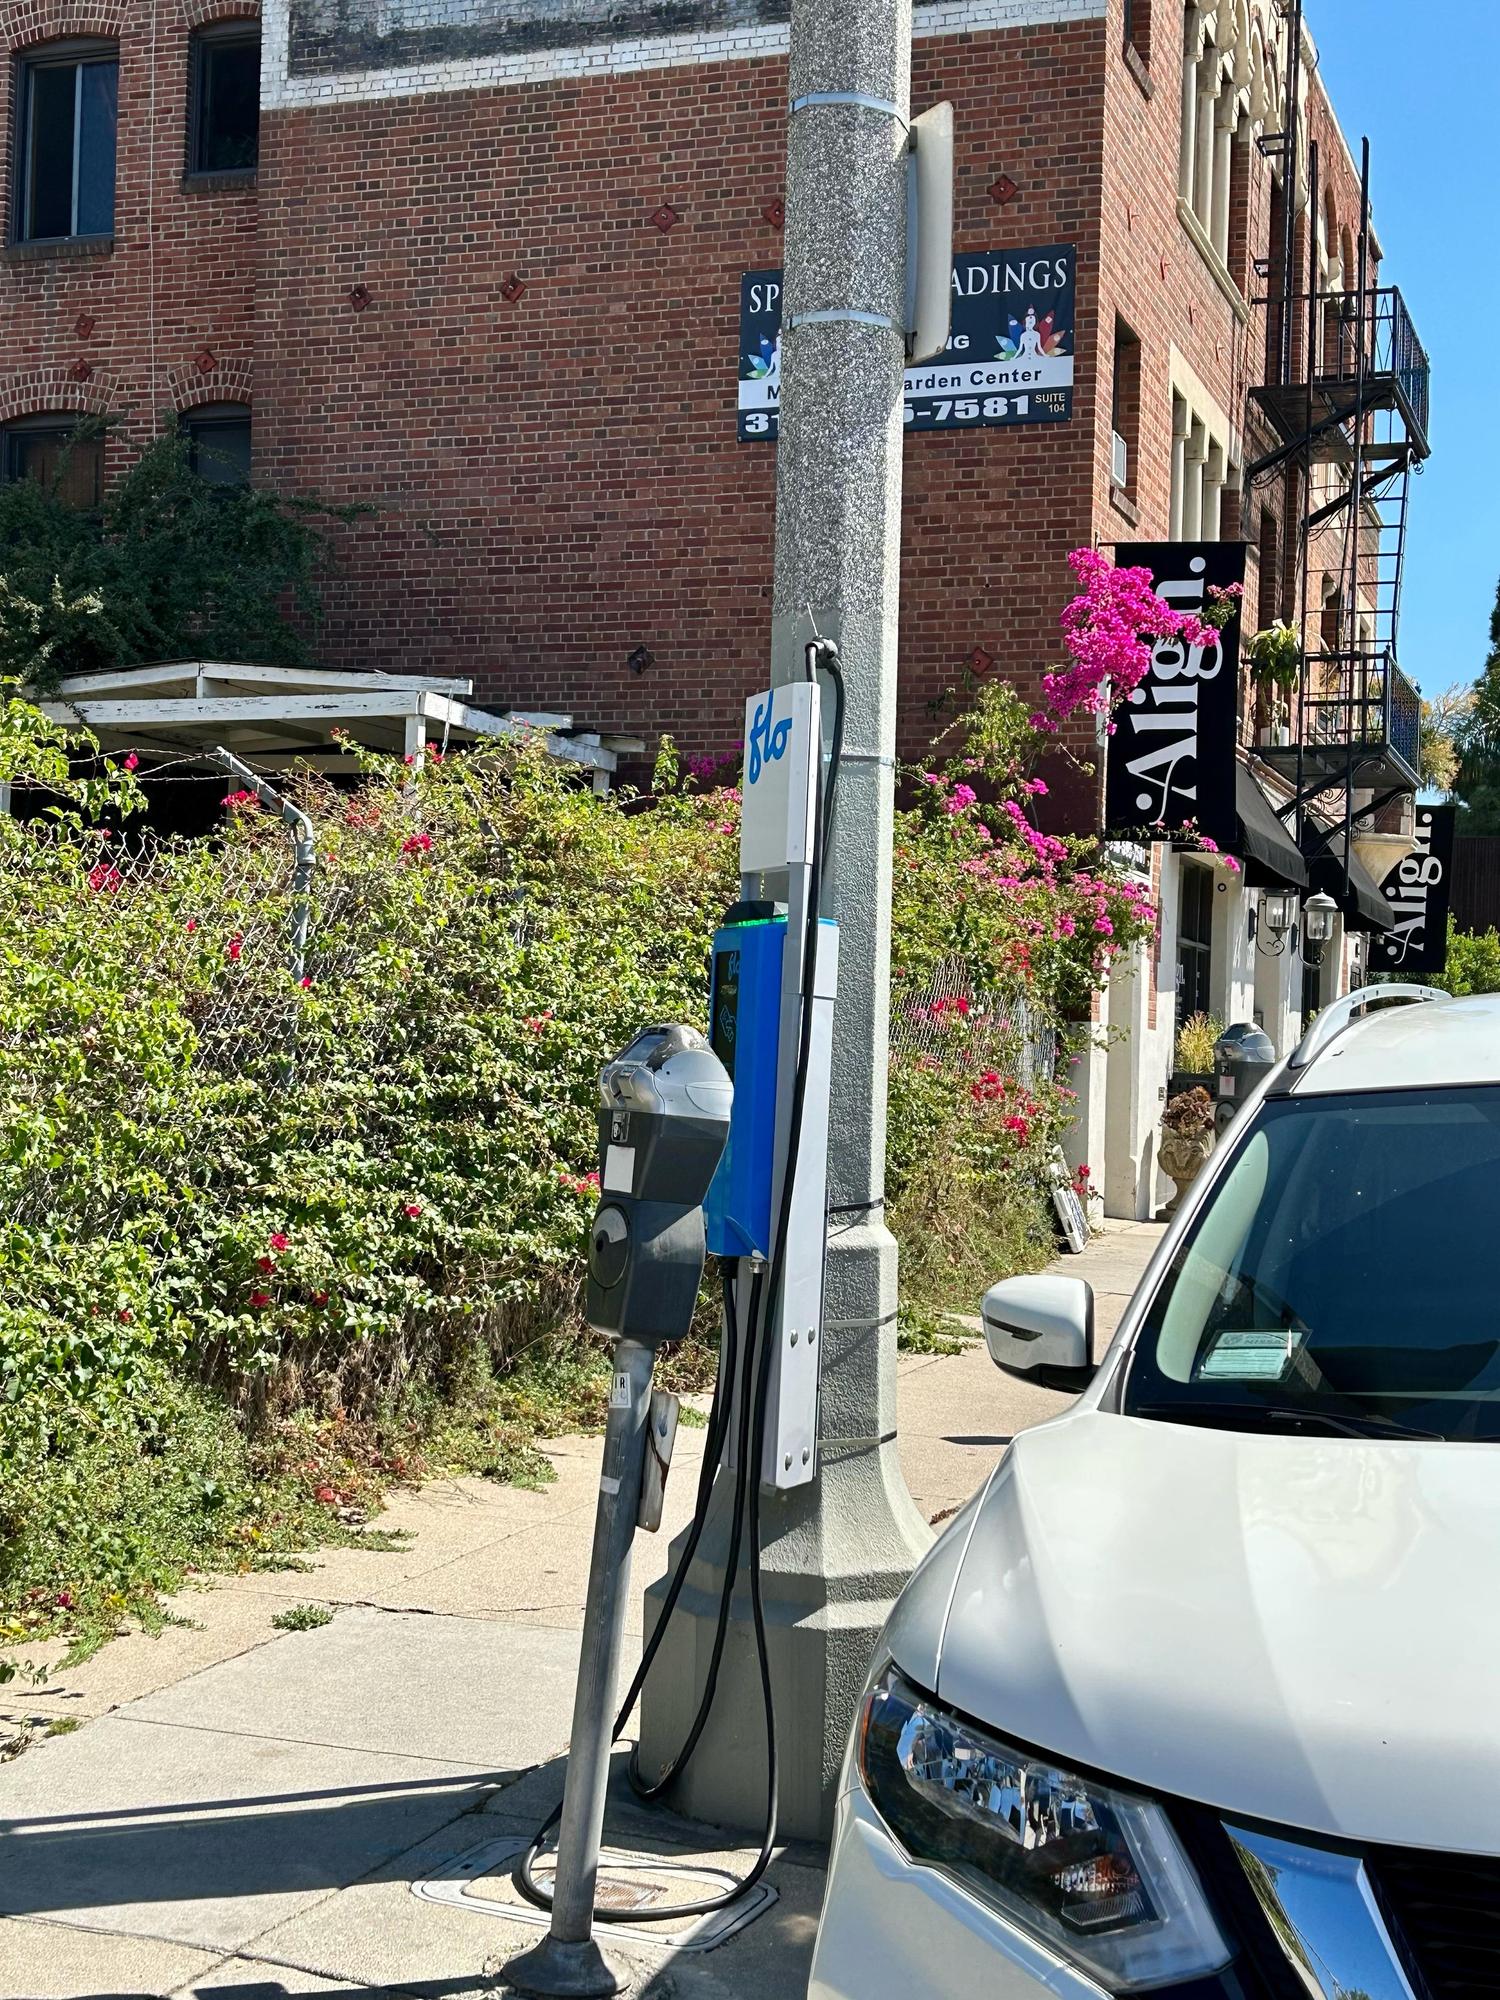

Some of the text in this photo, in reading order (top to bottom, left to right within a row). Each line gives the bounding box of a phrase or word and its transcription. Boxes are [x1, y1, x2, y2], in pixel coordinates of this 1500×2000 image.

[951, 258, 1067, 296] ADINGS
[904, 368, 1042, 391] arden Center
[1035, 393, 1066, 404] SUITE
[1049, 403, 1065, 413] 104
[749, 688, 792, 784] flo
